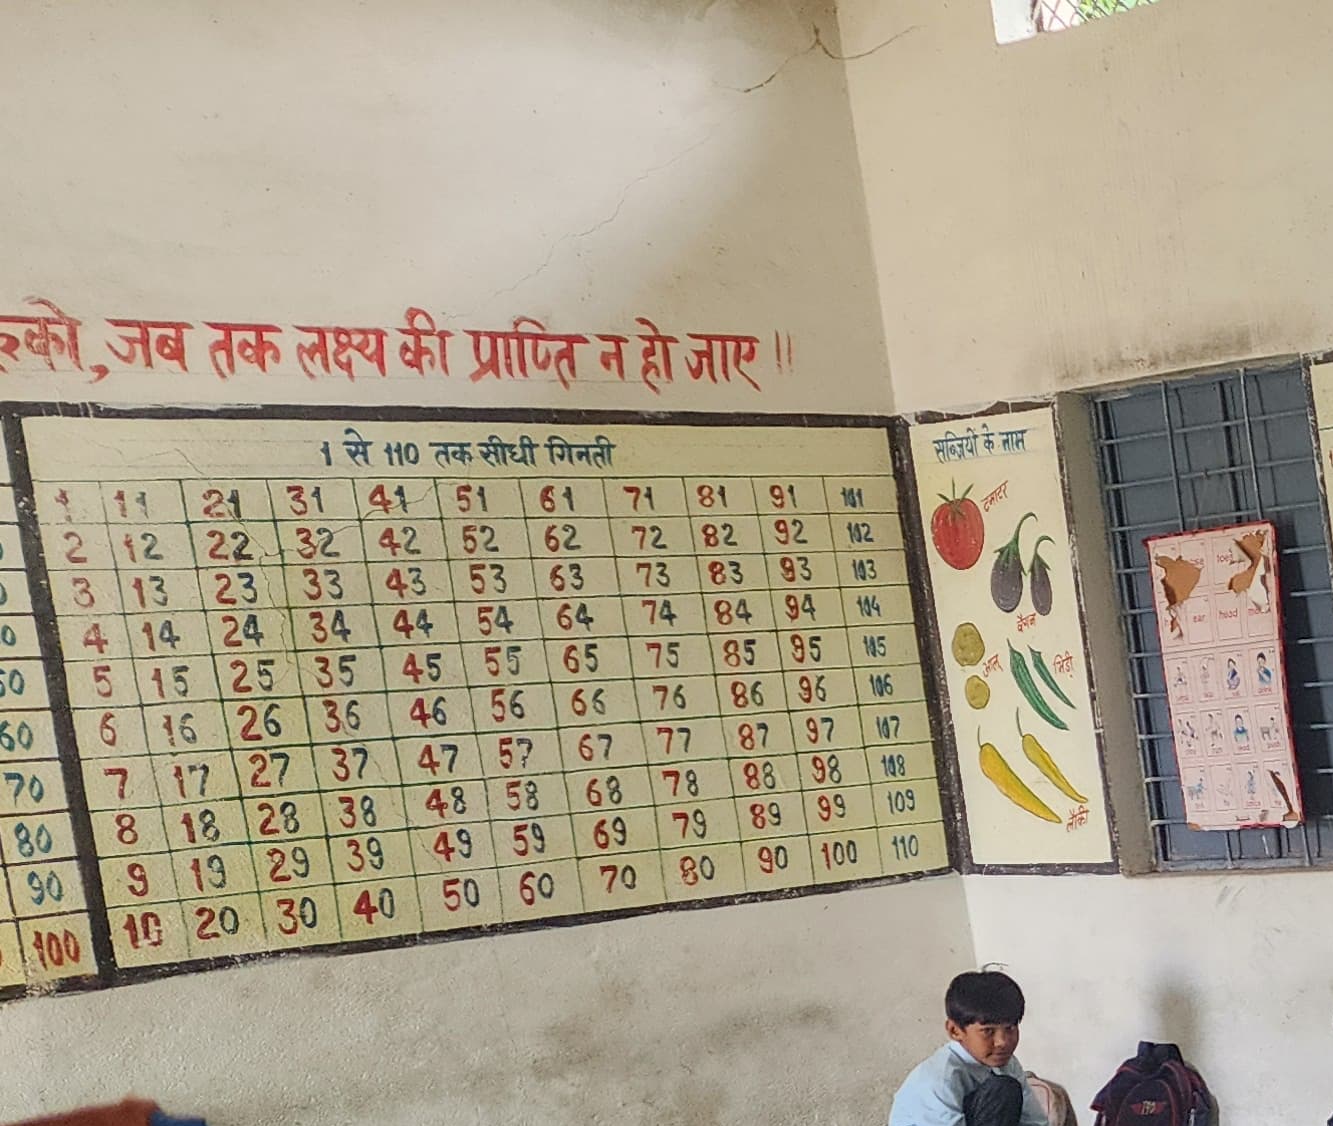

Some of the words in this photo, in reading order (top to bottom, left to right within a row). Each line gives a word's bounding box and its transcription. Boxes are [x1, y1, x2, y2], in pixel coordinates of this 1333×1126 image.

[105, 318, 194, 373] जब
[201, 321, 283, 381] तक
[292, 324, 388, 382] लक्ष्य
[396, 306, 456, 378] की
[594, 333, 630, 380] न
[634, 317, 680, 394] हो
[685, 332, 762, 392] जाए
[342, 429, 374, 467] से
[383, 443, 420, 467] 110
[429, 441, 472, 468] तक
[479, 435, 540, 467] सीधी
[544, 435, 617, 467] गिनती
[982, 422, 995, 455] के
[64, 532, 88, 564] 2
[123, 533, 159, 564] 12
[207, 530, 255, 562] 22
[295, 526, 341, 559] 32
[378, 525, 422, 557] 42
[462, 523, 500, 554] 52
[544, 522, 581, 552] 62
[631, 523, 668, 550] 72
[702, 521, 738, 548] 82
[775, 518, 808, 545] 92
[83, 623, 108, 654] 4
[142, 619, 181, 651] 14
[222, 613, 265, 646] 24
[309, 610, 352, 643] 34
[392, 608, 434, 635] 44
[477, 605, 514, 636] 54
[556, 602, 595, 630] 64
[641, 599, 677, 627] 74
[714, 599, 753, 626] 84
[786, 594, 817, 622] 94
[3, 772, 45, 805] 70
[115, 814, 139, 845] 8
[180, 809, 221, 844] 18
[258, 801, 301, 836] 28
[338, 795, 377, 829] 38
[425, 786, 468, 818] 48
[505, 780, 540, 811] 58
[586, 775, 623, 807] 68
[661, 770, 700, 797] 78
[742, 760, 777, 790] 88
[811, 754, 842, 784] 98
[14, 822, 52, 858] 80
[27, 870, 63, 905] 90
[122, 912, 162, 950] 10
[194, 905, 240, 941] 20
[276, 896, 318, 935] 30
[353, 887, 396, 925] 40
[443, 878, 480, 912] 50
[519, 871, 555, 905] 60
[599, 864, 637, 894] 70
[679, 856, 716, 886] 80
[757, 845, 788, 875] 90
[821, 842, 858, 871] 100
[32, 929, 81, 969] 100
